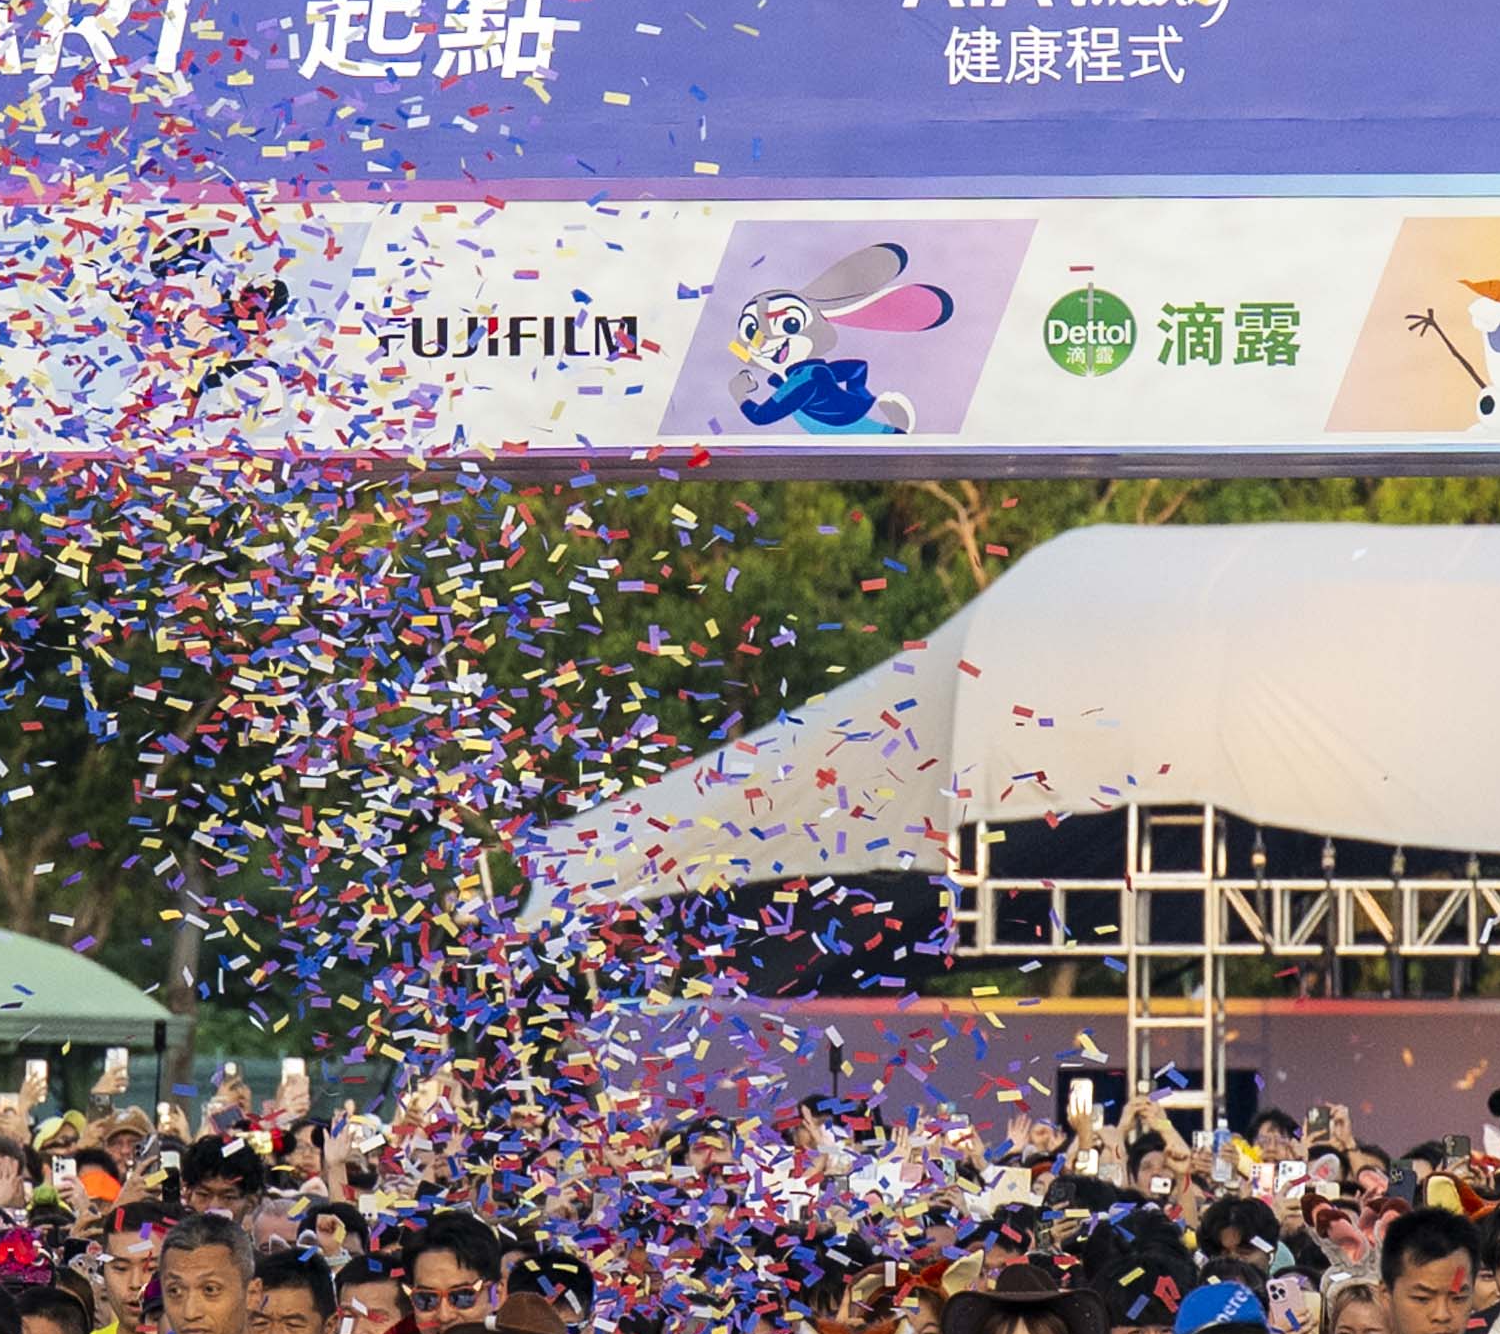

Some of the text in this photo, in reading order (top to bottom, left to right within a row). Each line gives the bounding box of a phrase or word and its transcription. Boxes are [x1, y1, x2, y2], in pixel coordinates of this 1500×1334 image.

[943, 25, 1186, 85] 健康程式
[377, 316, 639, 358] FUJIFILM
[1047, 319, 1132, 346] Dettol
[1157, 301, 1301, 366] 滴露
